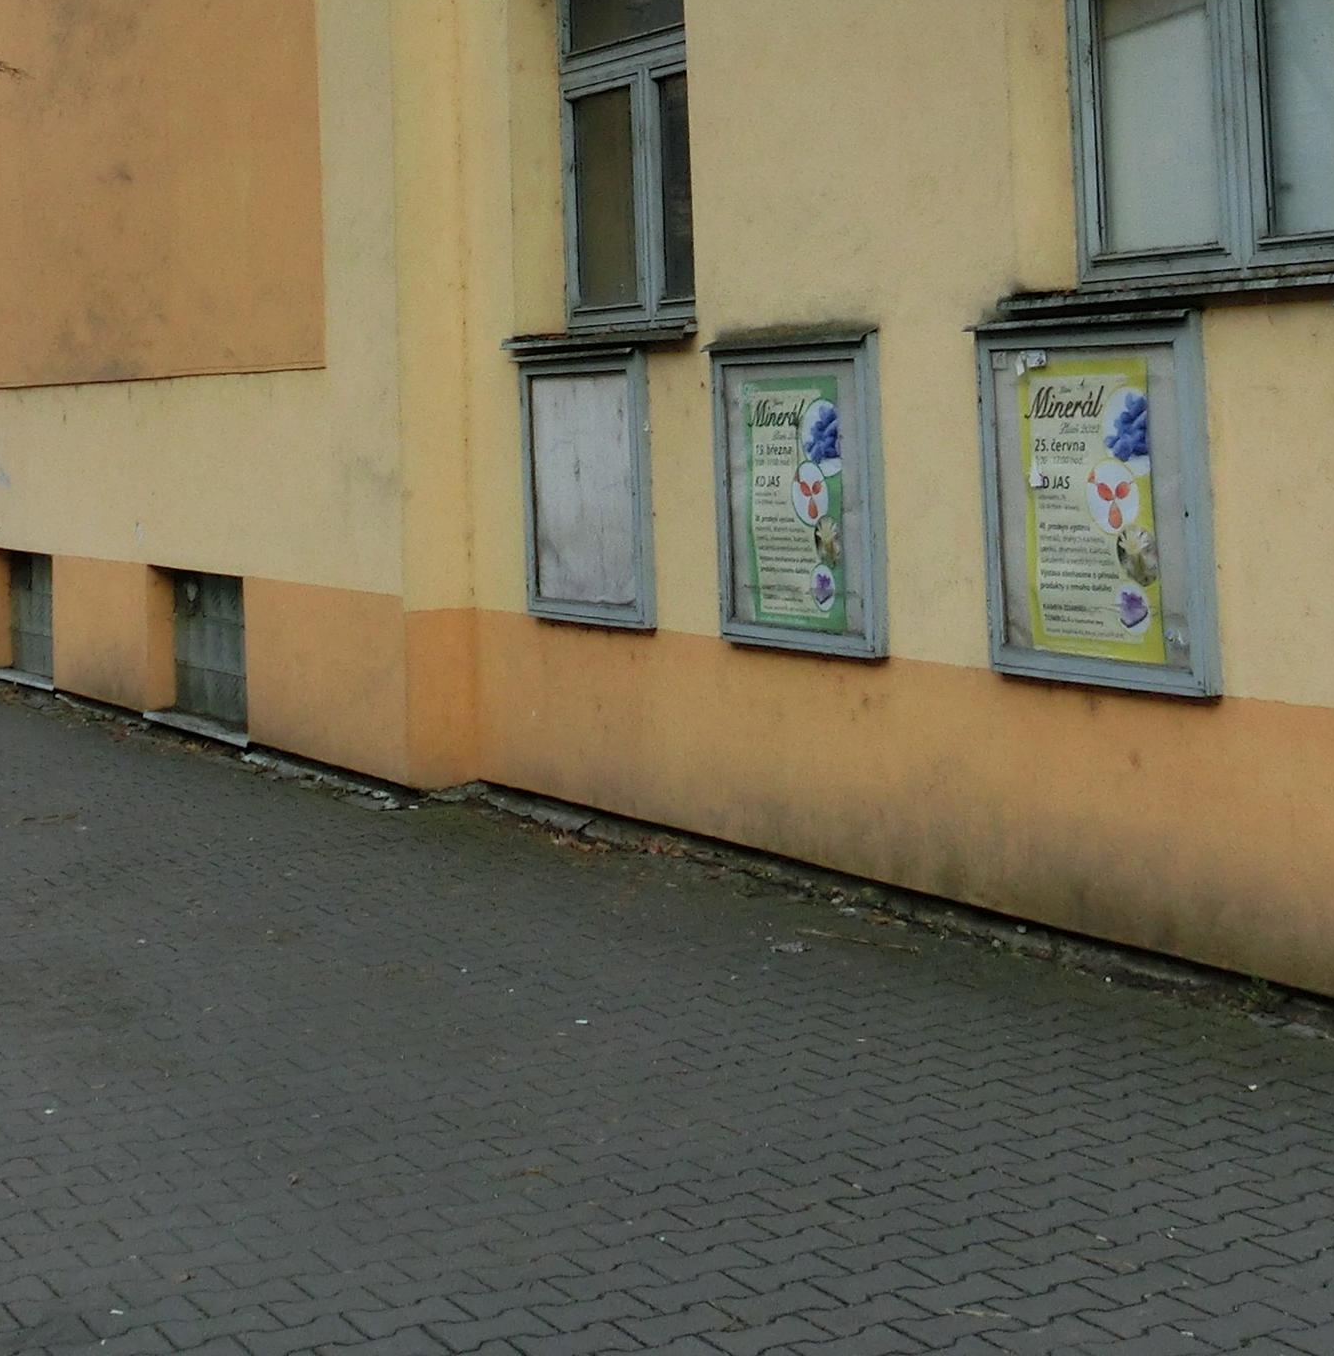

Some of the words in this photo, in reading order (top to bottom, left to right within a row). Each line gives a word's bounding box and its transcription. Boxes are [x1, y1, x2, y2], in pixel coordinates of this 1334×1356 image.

[1024, 385, 1104, 419] Minerál
[1034, 439, 1049, 452] 25.
[1050, 438, 1086, 452] června
[1052, 475, 1071, 489] JAS
